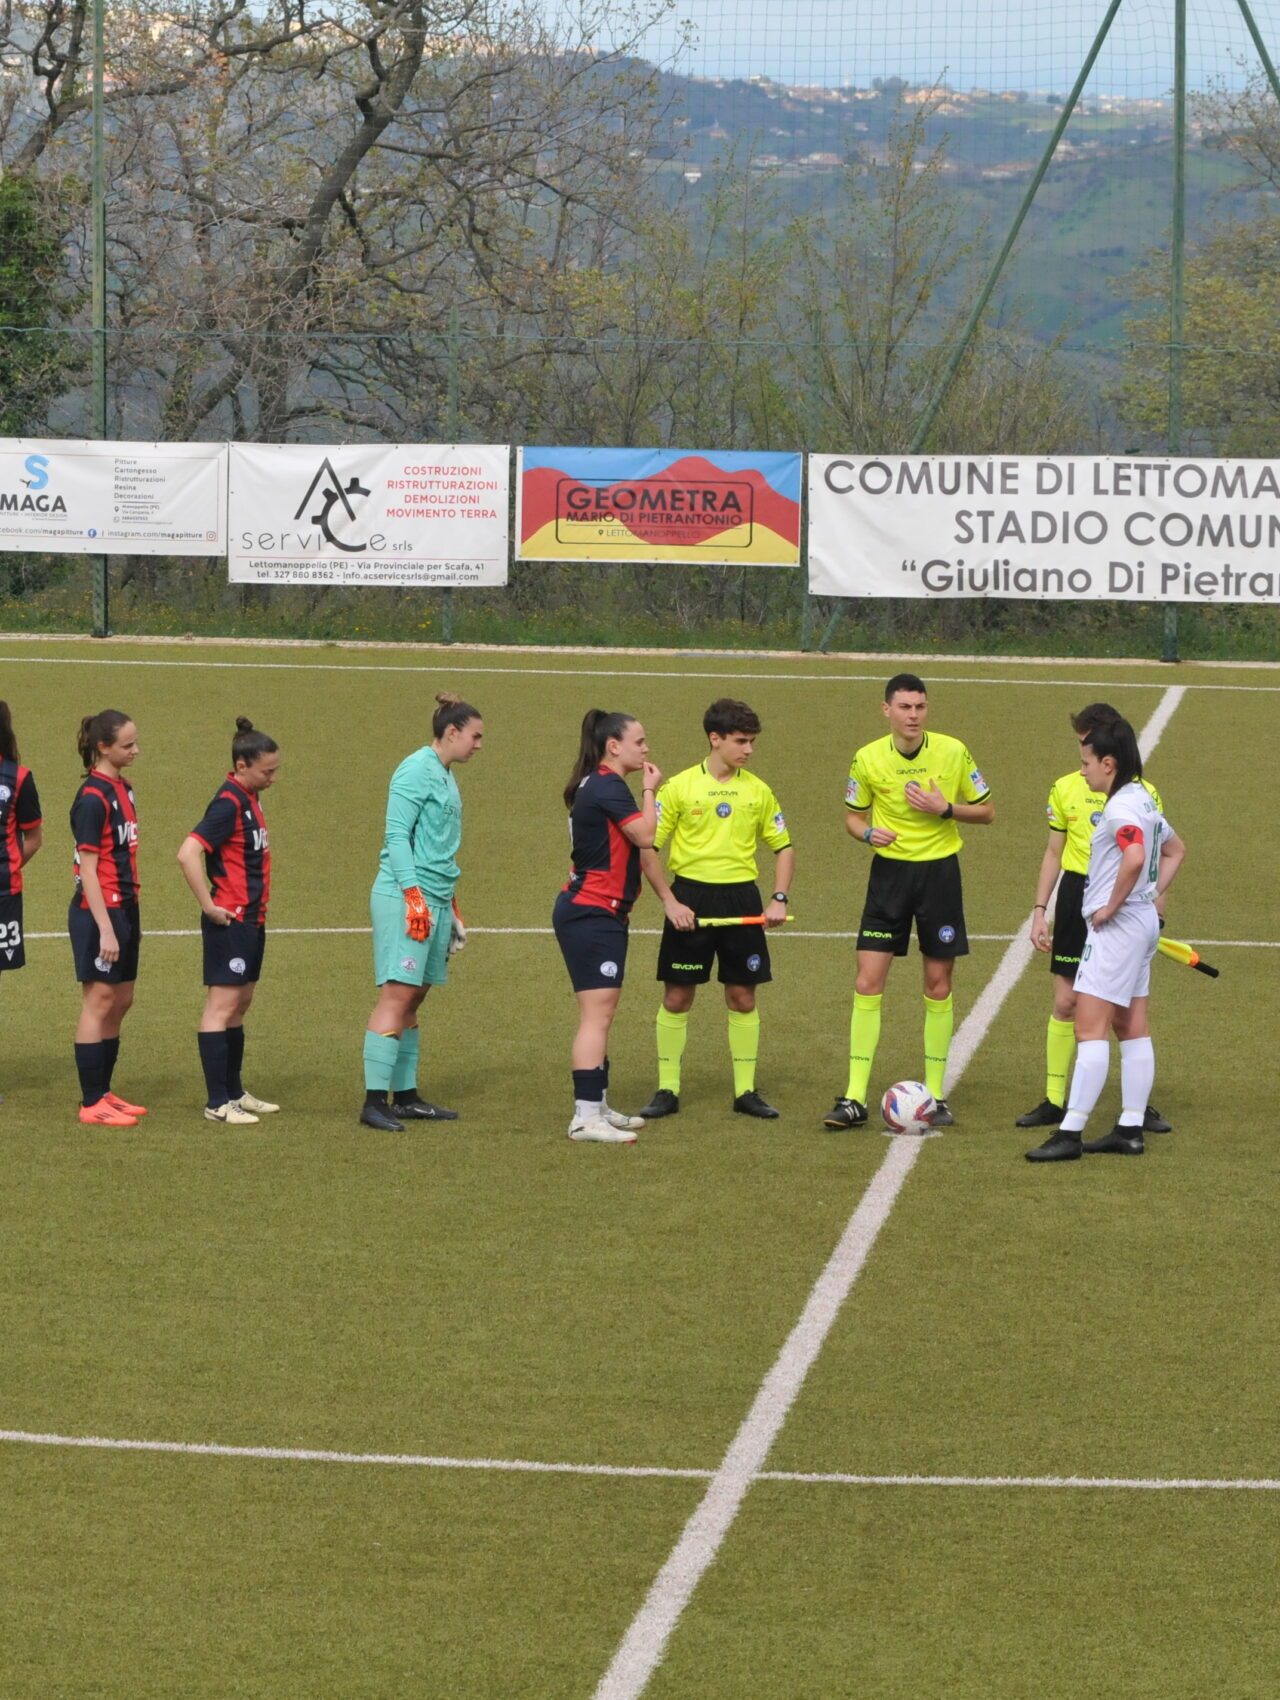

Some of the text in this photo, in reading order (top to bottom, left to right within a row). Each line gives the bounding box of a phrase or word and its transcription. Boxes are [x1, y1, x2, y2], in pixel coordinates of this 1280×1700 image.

[114, 457, 137, 465] Pitture
[114, 466, 157, 475] Cartongesso
[403, 466, 482, 476] COSTRUZIONI
[114, 475, 166, 483] Ristrutturazioni
[823, 459, 1280, 499] COMUNE DI LETTOMA
[387, 480, 498, 491] RISTRUTTURAZIONI
[113, 492, 155, 500] Decorazioni
[404, 494, 480, 505] DEMOLIZIONI
[566, 487, 743, 513] GEOMETRA
[0, 493, 68, 513] MAGA
[386, 508, 498, 520] MOVIMENTO TERRA
[566, 511, 743, 526] MARIO DI PIETRANTONIO
[953, 508, 1109, 545] STADIO
[392, 540, 413, 552] srls
[249, 560, 328, 572] Lettomanoppello
[329, 561, 348, 571] (PE)
[356, 561, 371, 570] Via
[373, 561, 424, 571] Provinciale
[426, 563, 442, 573] per
[444, 562, 473, 572] Scafa,
[475, 562, 485, 571] 41
[257, 570, 271, 579] tel.
[274, 570, 290, 579] 327
[1108, 560, 1145, 594] Di
[1161, 562, 1280, 597] Pietra
[671, 962, 703, 971] GIVOVA
